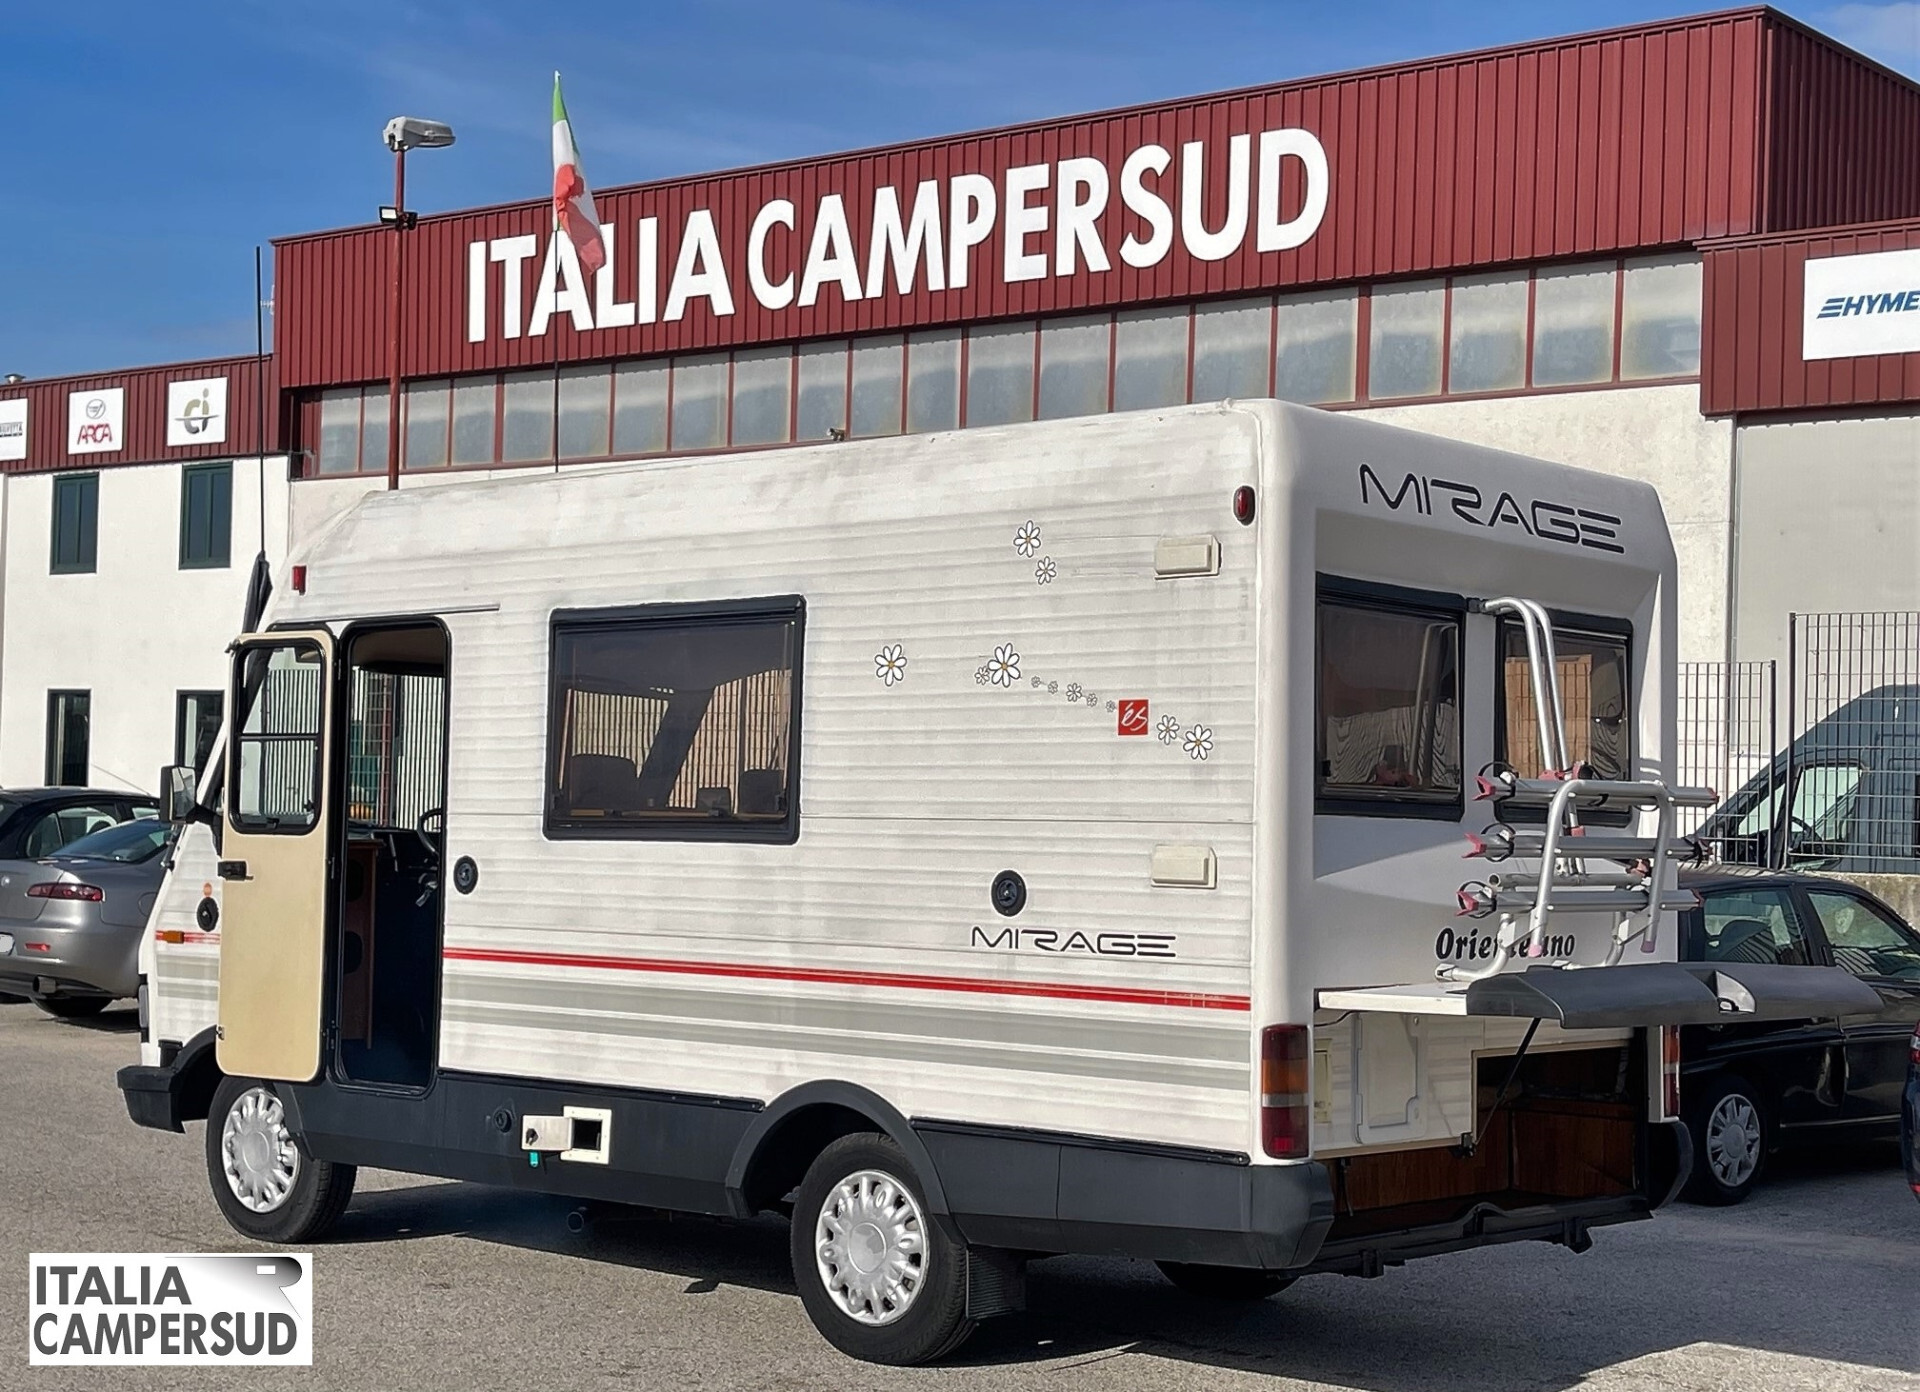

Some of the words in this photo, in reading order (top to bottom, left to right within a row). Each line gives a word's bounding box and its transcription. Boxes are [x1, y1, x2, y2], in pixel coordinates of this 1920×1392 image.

[468, 208, 735, 343] ITALIA
[748, 128, 1329, 310] CAMPERSUD
[1842, 290, 1920, 317] HYME
[77, 423, 112, 445] ARCA
[1359, 463, 1625, 554] MIRAGE
[971, 926, 1176, 957] MIRAGE
